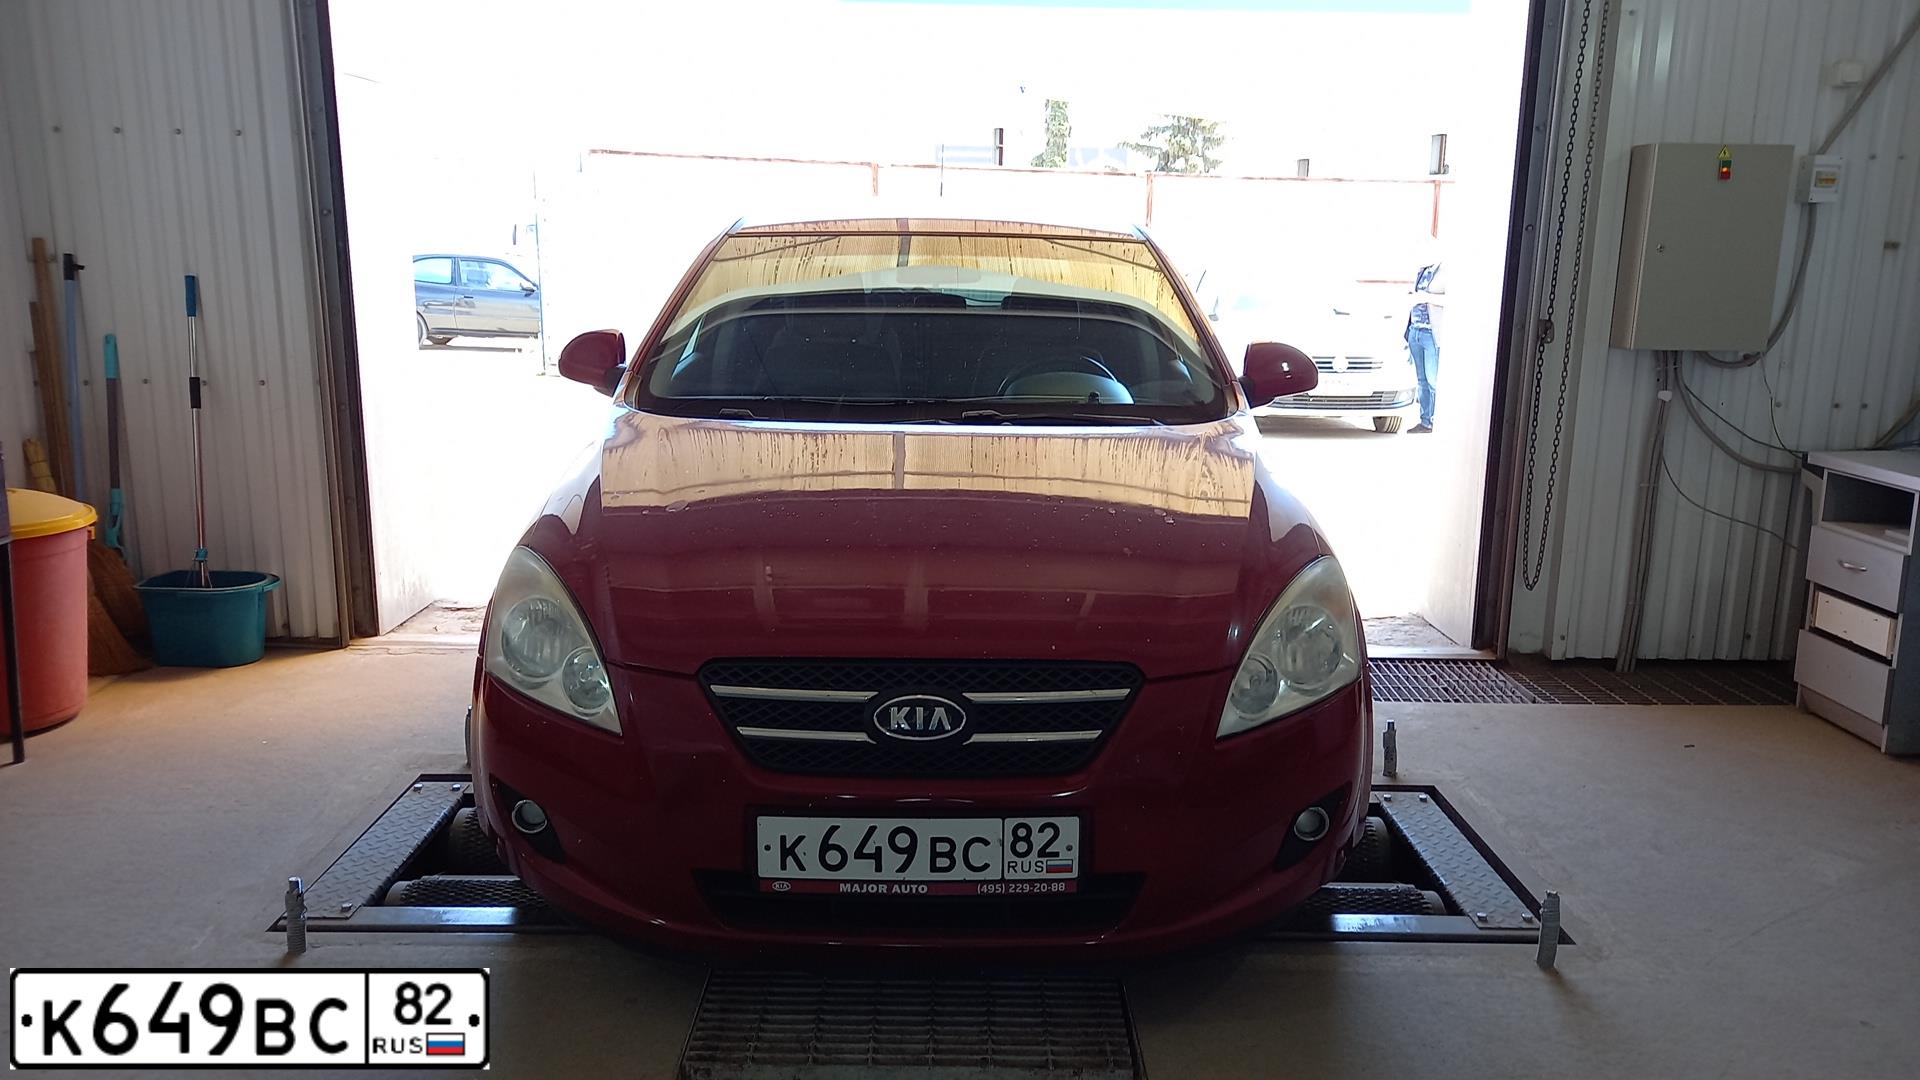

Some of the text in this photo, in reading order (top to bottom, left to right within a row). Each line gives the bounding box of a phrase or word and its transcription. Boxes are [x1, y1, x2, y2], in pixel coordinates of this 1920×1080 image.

[888, 706, 952, 731] KIA
[1010, 822, 1060, 858] 82
[1007, 860, 1044, 873] RUS
[839, 884, 928, 894] MAJOR AUTO
[977, 883, 1066, 895] (495) 229-20-88
